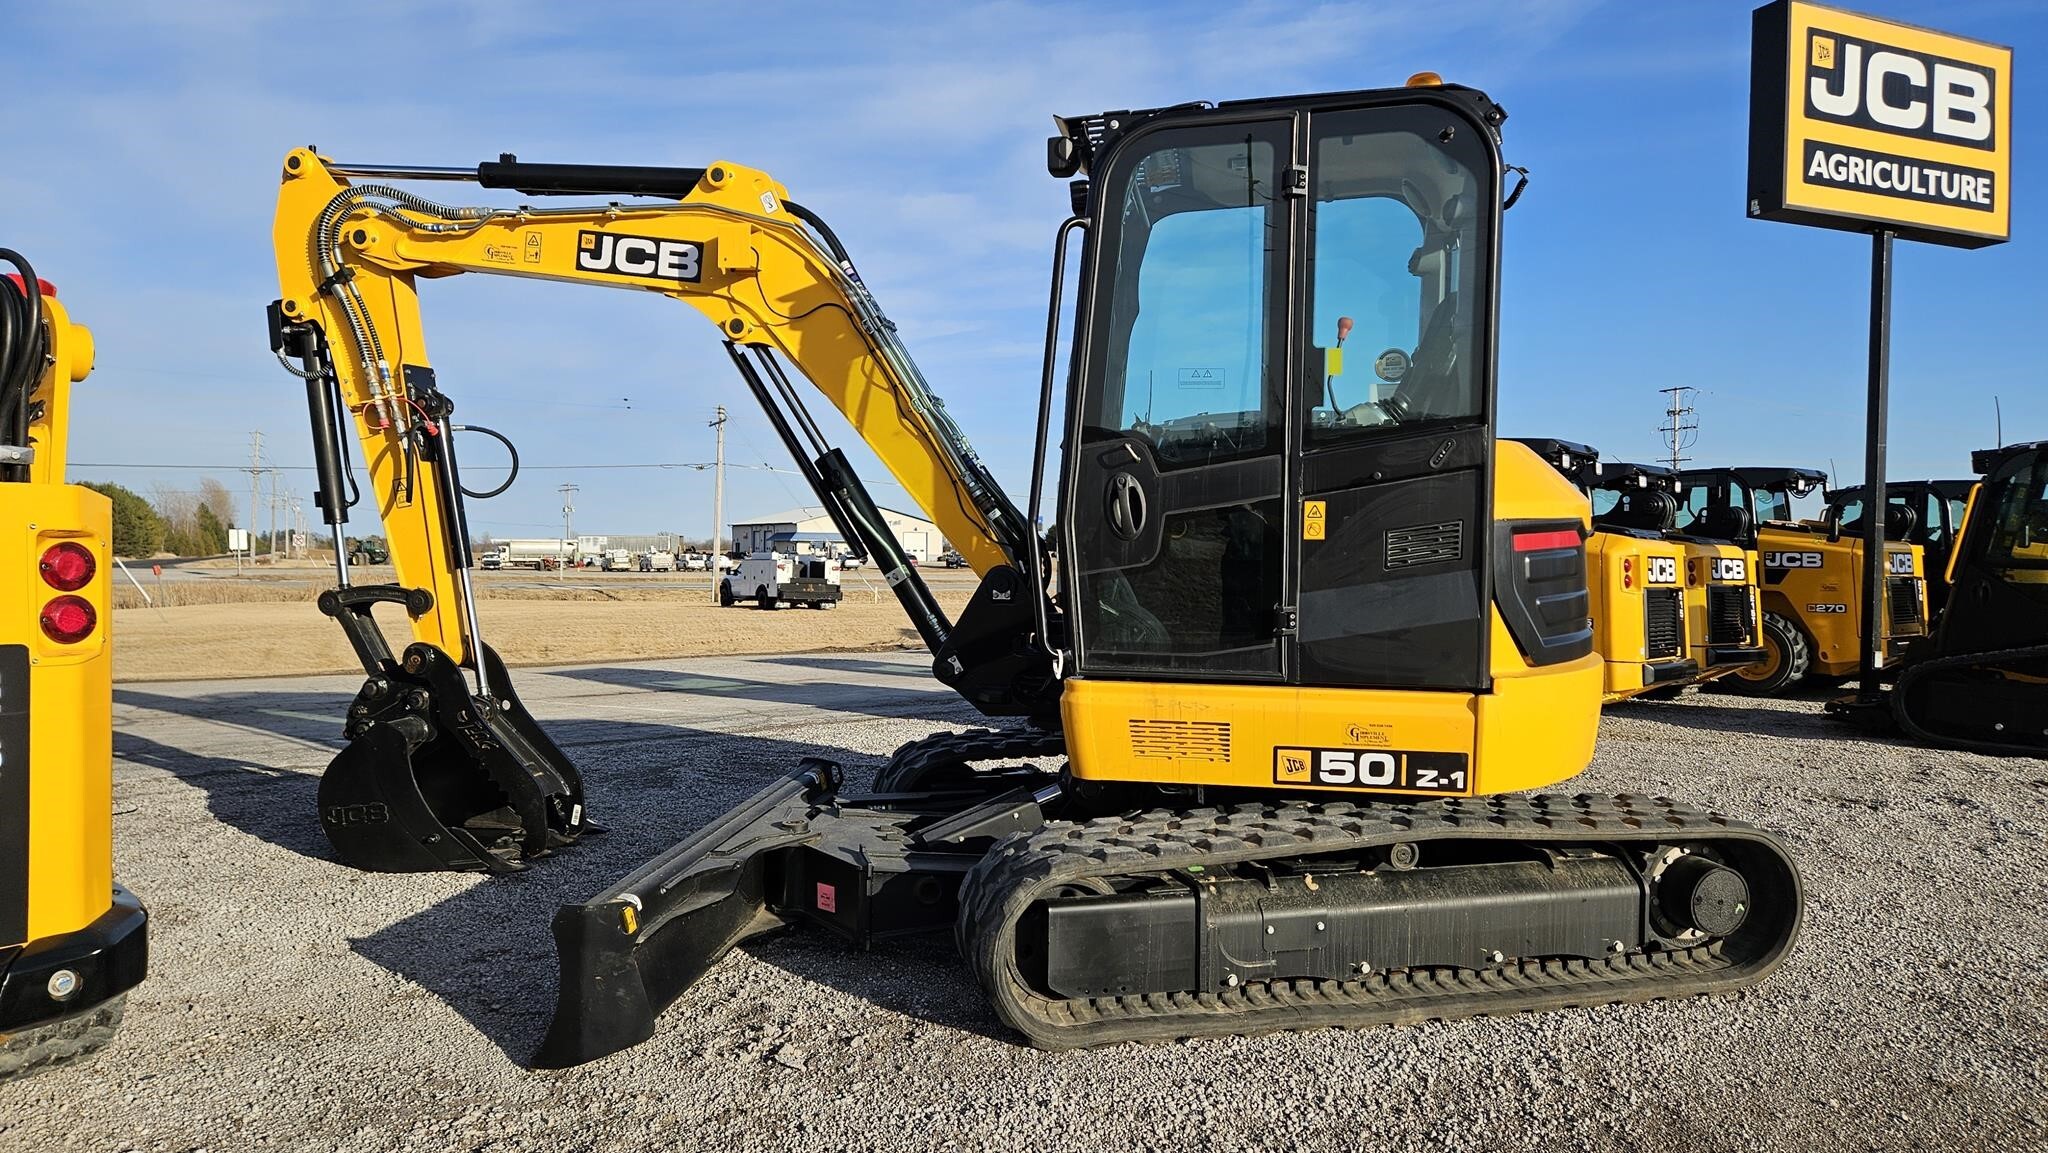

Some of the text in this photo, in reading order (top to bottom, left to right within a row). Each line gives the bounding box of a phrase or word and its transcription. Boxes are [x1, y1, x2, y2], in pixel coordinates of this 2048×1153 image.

[1810, 43, 1992, 141] JCB
[1807, 149, 1991, 205] AGRICULTURE
[579, 235, 699, 279] JCB
[1648, 557, 1676, 583] JCB
[1712, 558, 1745, 580] JCB
[1765, 552, 1822, 567] JCB
[1890, 553, 1913, 573] JCB
[1815, 604, 1846, 613] 270
[1285, 757, 1306, 774] JCB
[1319, 750, 1465, 790] 50 Z-1
[327, 801, 389, 826] JCB
